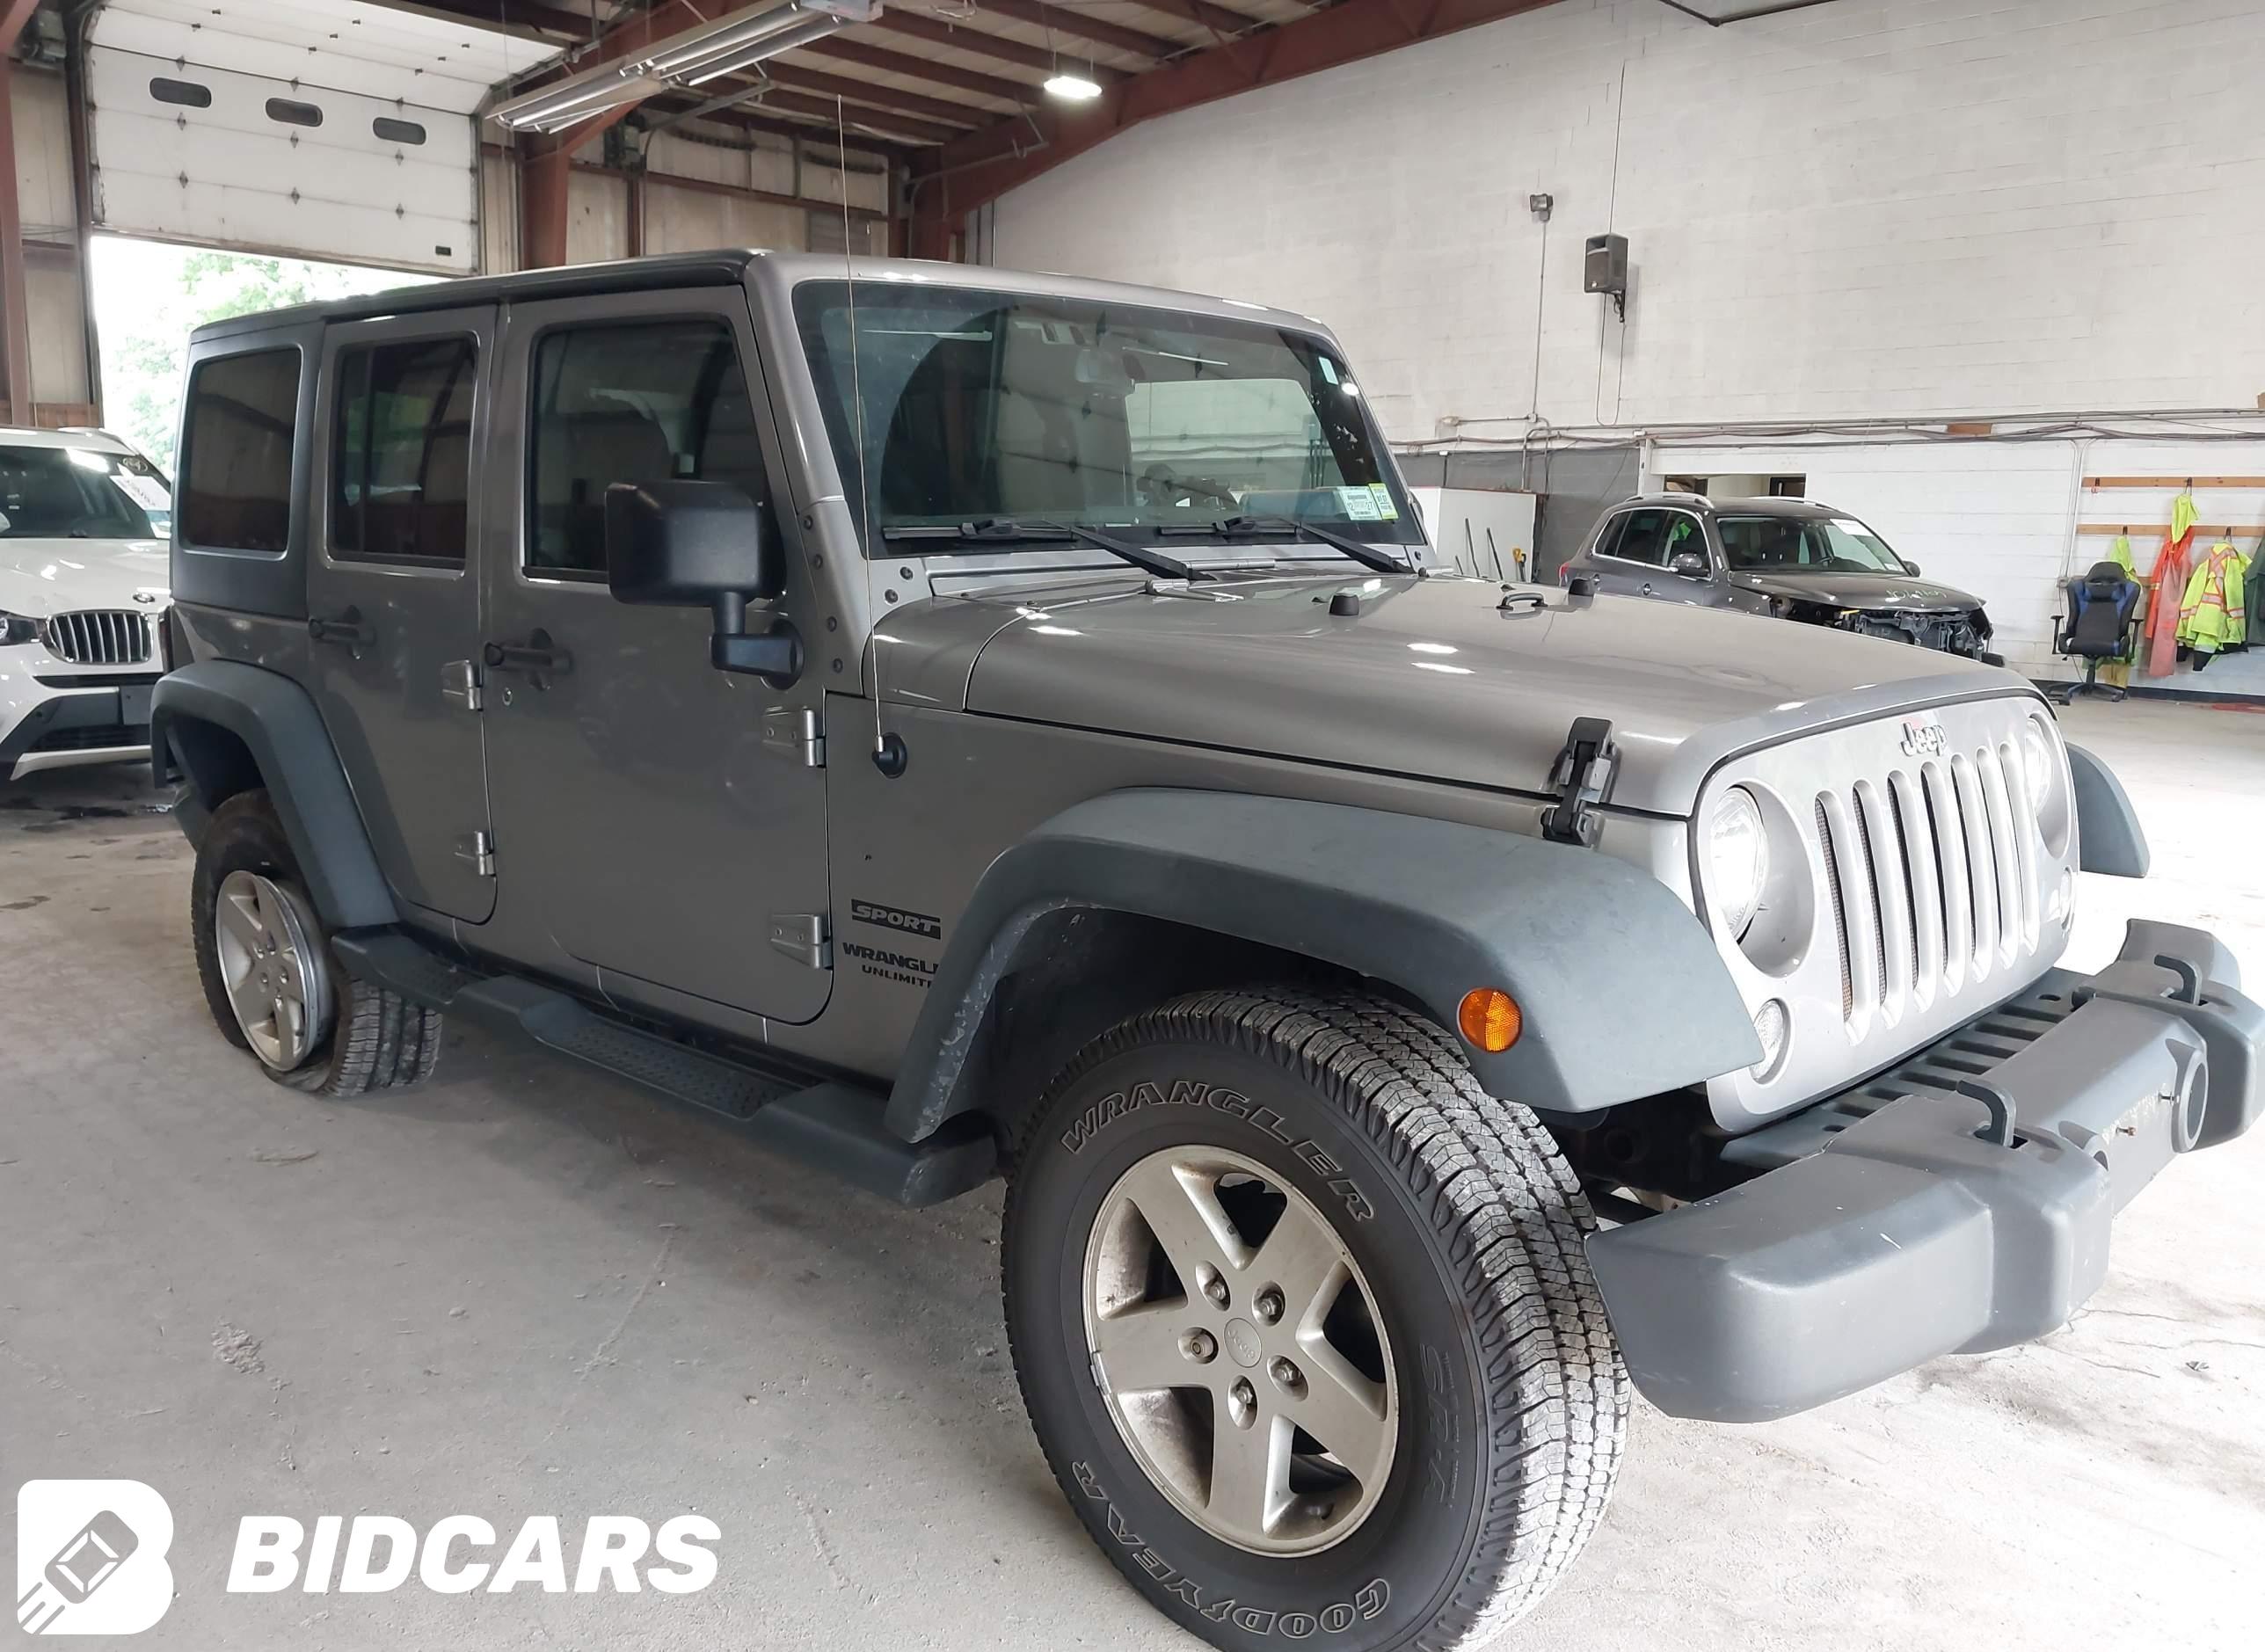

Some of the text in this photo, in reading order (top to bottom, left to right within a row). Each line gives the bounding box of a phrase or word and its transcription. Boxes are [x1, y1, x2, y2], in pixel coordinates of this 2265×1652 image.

[1899, 721, 1947, 757] Jeep
[855, 904, 941, 933] SPORT
[1060, 1079, 1378, 1222] WRANGLER
[1071, 1459, 1392, 1640] GOODYEAR
